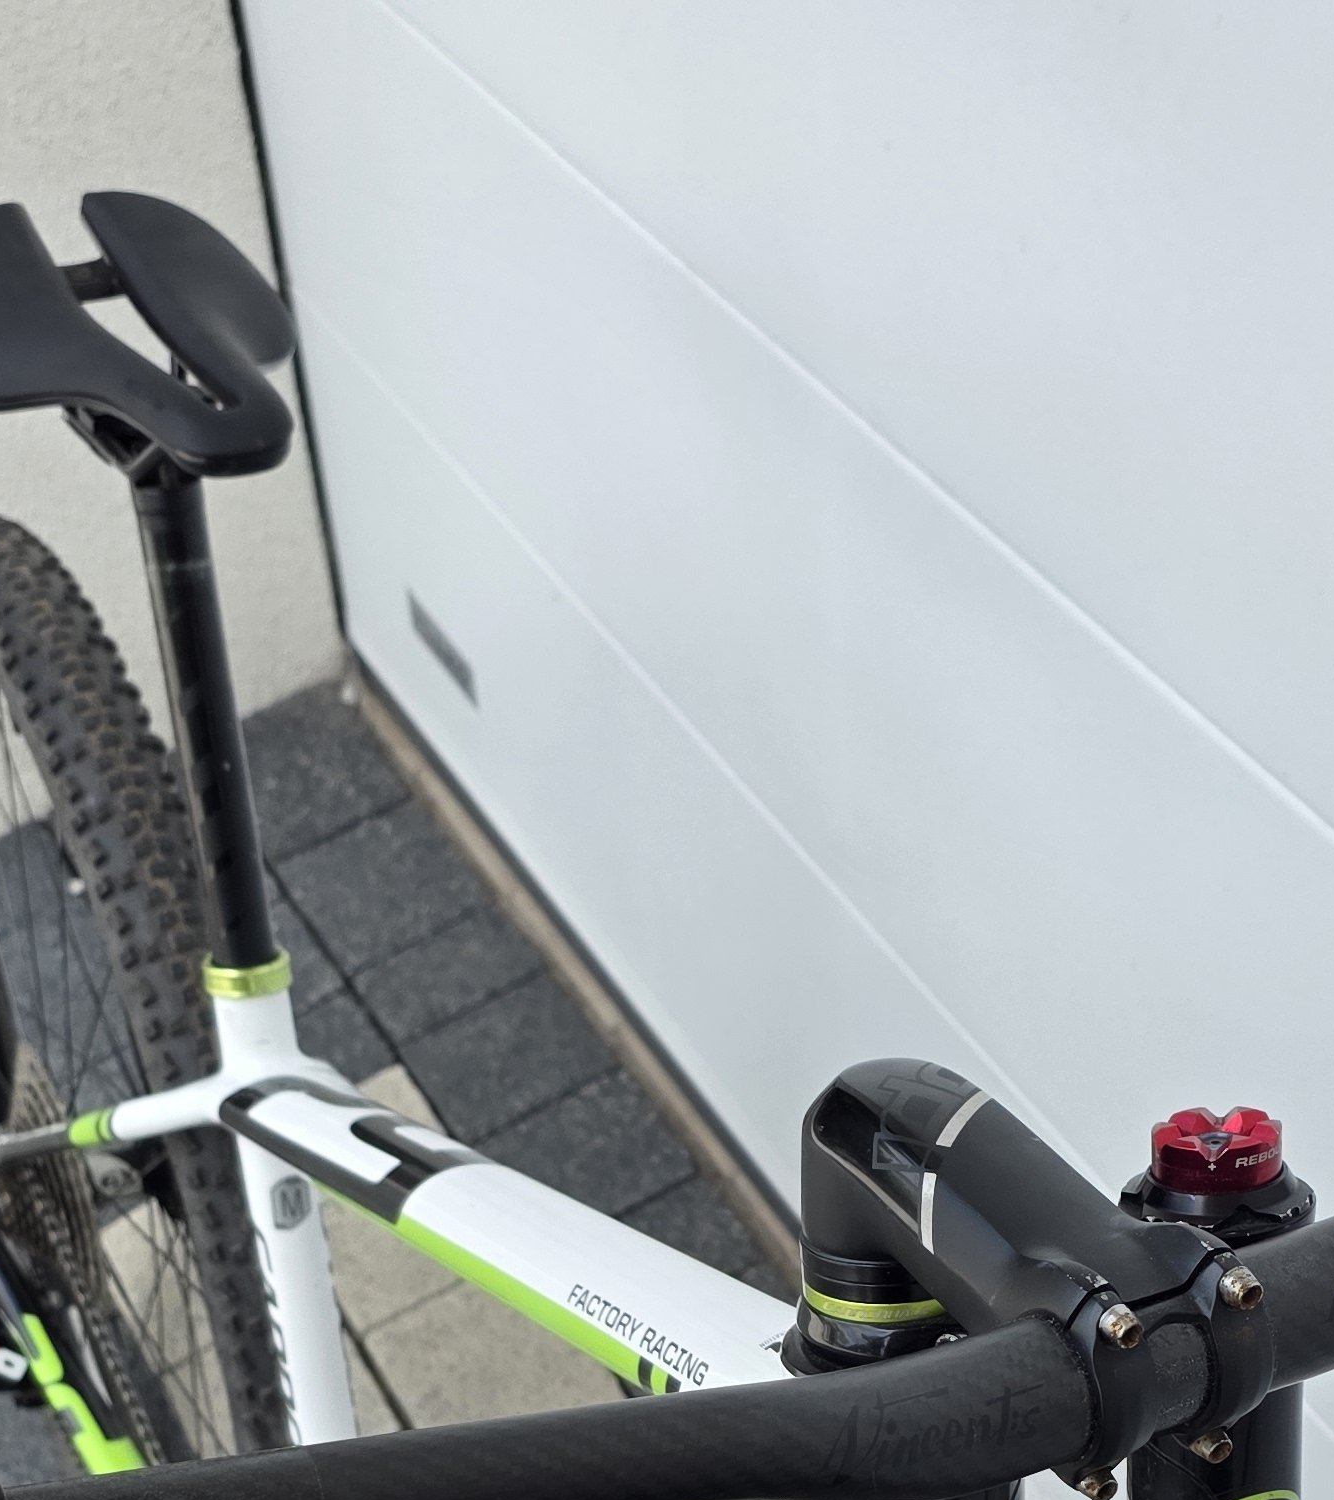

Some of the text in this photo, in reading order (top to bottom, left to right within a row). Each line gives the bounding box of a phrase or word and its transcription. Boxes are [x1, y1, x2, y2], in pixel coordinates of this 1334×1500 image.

[1235, 1146, 1280, 1169] REBO
[567, 1284, 709, 1387] FACTORY RACING
